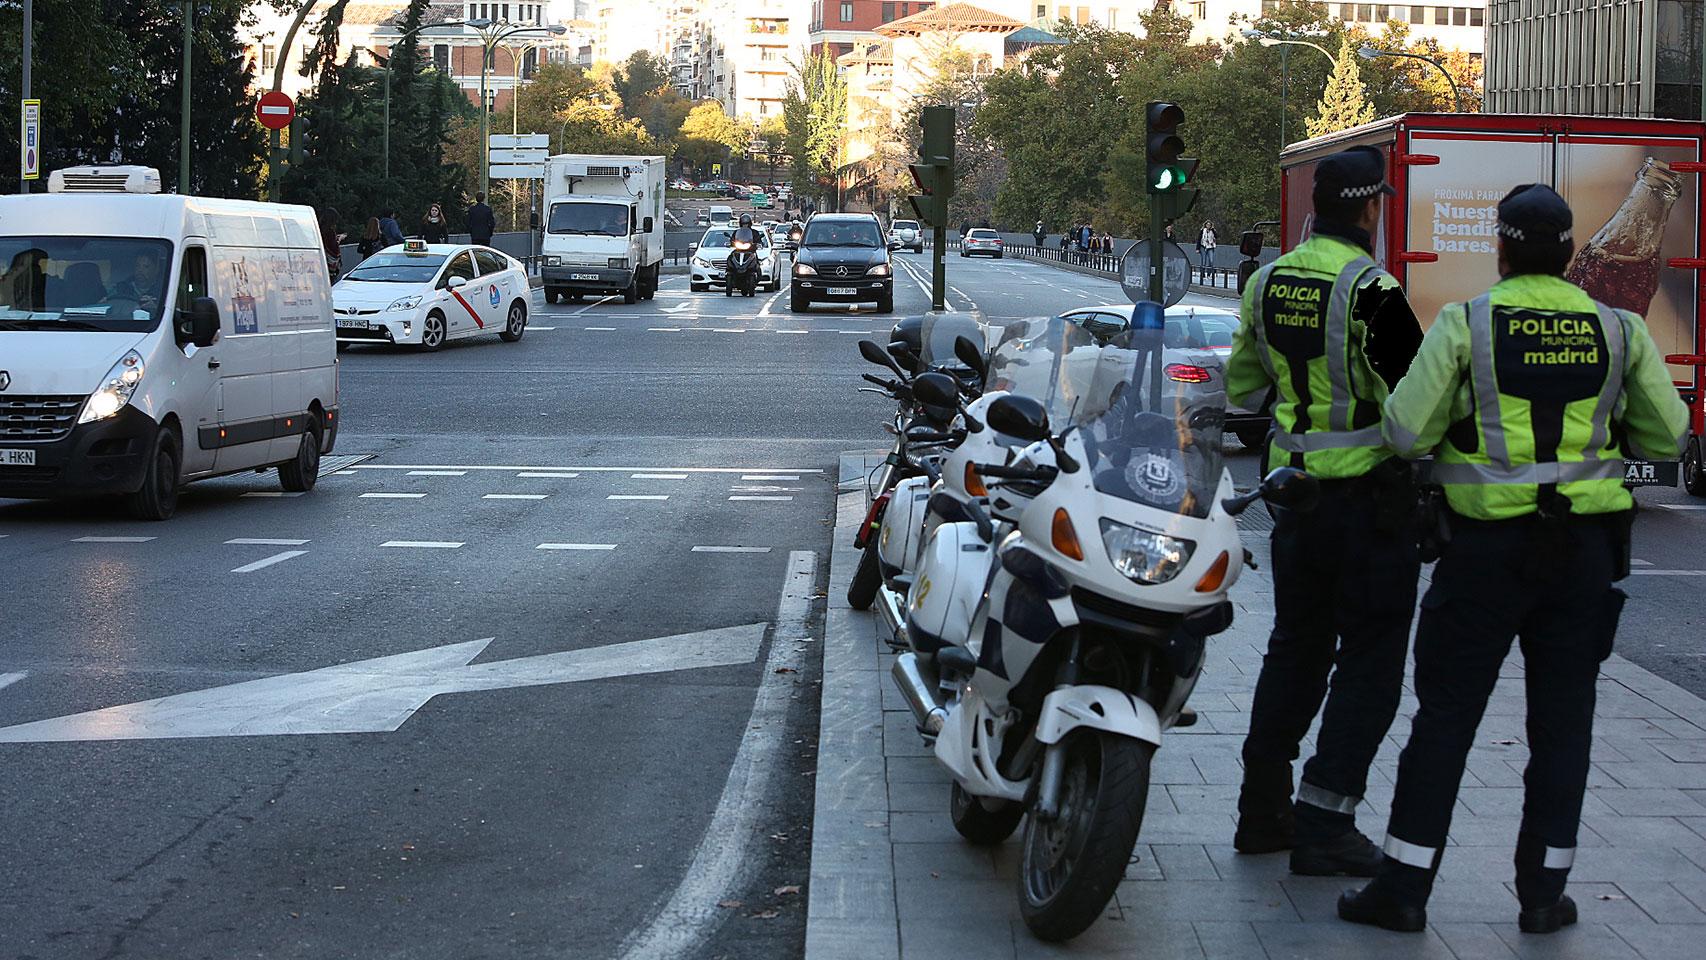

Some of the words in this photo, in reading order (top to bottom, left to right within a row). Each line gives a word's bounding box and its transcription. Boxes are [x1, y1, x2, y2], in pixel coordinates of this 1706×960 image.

[1477, 190, 1508, 201] PARAD
[1433, 202, 1498, 219] Nuest
[1432, 236, 1497, 253] bares.
[1268, 284, 1320, 302] POLICIA
[1275, 311, 1319, 328] madrid
[1508, 318, 1595, 335] POLICIA
[1541, 335, 1597, 346] MUNICIPAL
[1523, 347, 1598, 364] madrid
[9, 451, 33, 463] HKN
